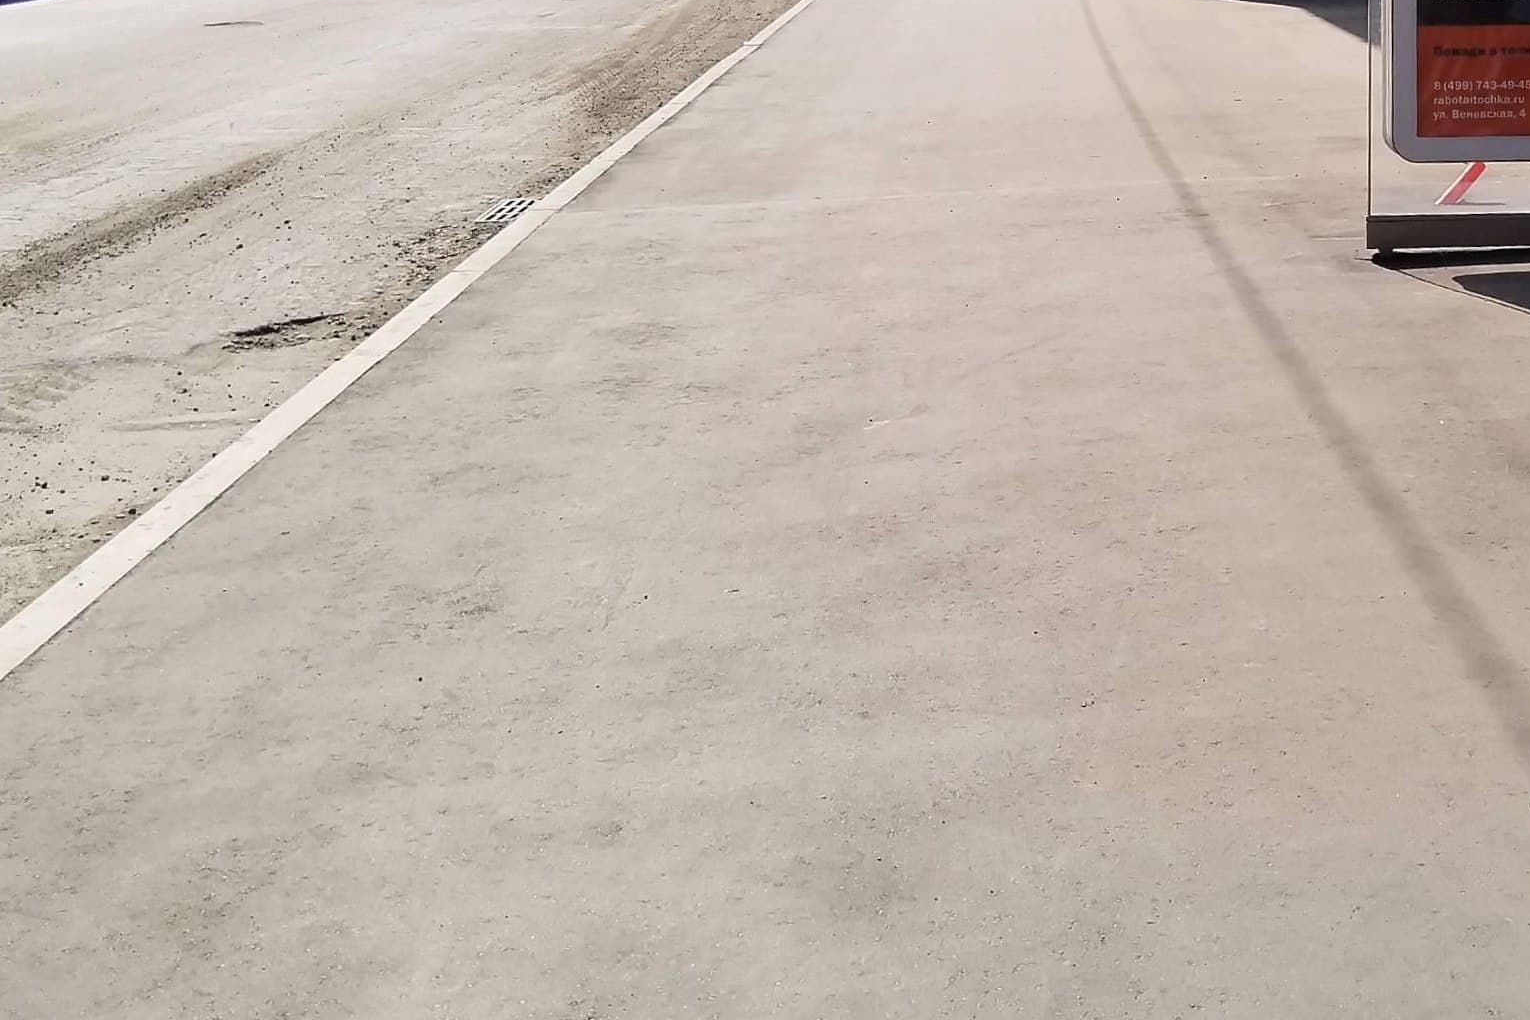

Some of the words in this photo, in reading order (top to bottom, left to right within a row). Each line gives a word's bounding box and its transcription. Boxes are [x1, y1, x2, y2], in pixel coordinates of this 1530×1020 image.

[1433, 81, 1441, 91] 8
[1443, 81, 1473, 92] (499)
[1433, 110, 1448, 121] ул.
[1519, 108, 1527, 118] 4
